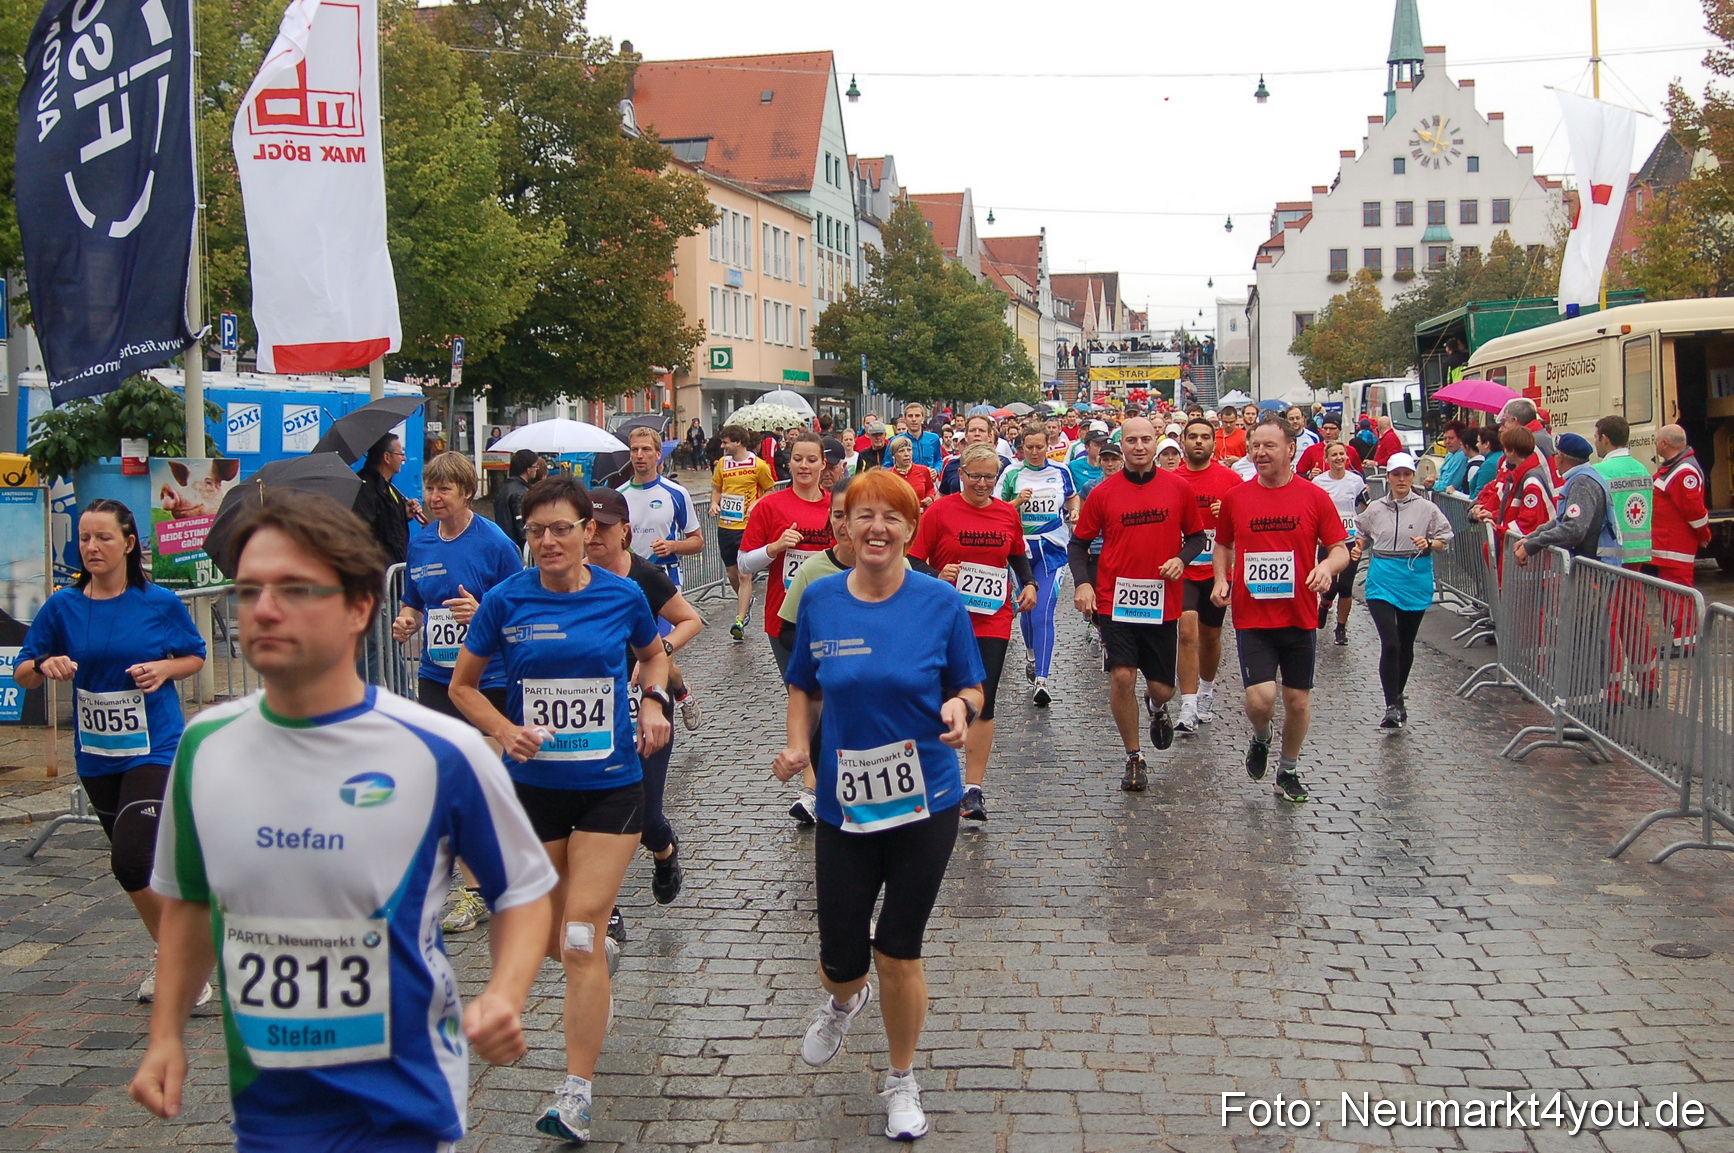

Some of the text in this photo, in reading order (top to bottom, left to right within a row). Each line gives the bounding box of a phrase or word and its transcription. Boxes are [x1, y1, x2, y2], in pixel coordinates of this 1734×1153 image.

[224, 319, 234, 346] P
[455, 342, 462, 362] P
[713, 350, 729, 367] D
[1119, 369, 1150, 378] START
[1546, 357, 1597, 383] Bayerisches
[1546, 385, 1569, 405] Rotes
[722, 499, 742, 511] 2976
[1024, 499, 1055, 513] 2812
[1248, 563, 1290, 581] 2682
[961, 574, 1003, 597] 2733
[967, 597, 992, 608] Andrea
[1118, 588, 1160, 607] 2939
[1124, 609, 1151, 618] Andreas
[432, 623, 468, 645] 262
[525, 687, 598, 695] PARTL Neumarkt
[94, 698, 130, 706] Neumarkt
[82, 706, 139, 732] 3055
[532, 698, 606, 730] 3034
[549, 737, 589, 749] Christa
[859, 752, 901, 767] Neumarkt
[841, 762, 915, 802] 3118
[256, 826, 345, 851] Stefan
[227, 928, 355, 948] PARTL Neumarkt
[237, 952, 372, 1010] 2813
[266, 1024, 337, 1047] Stefan
